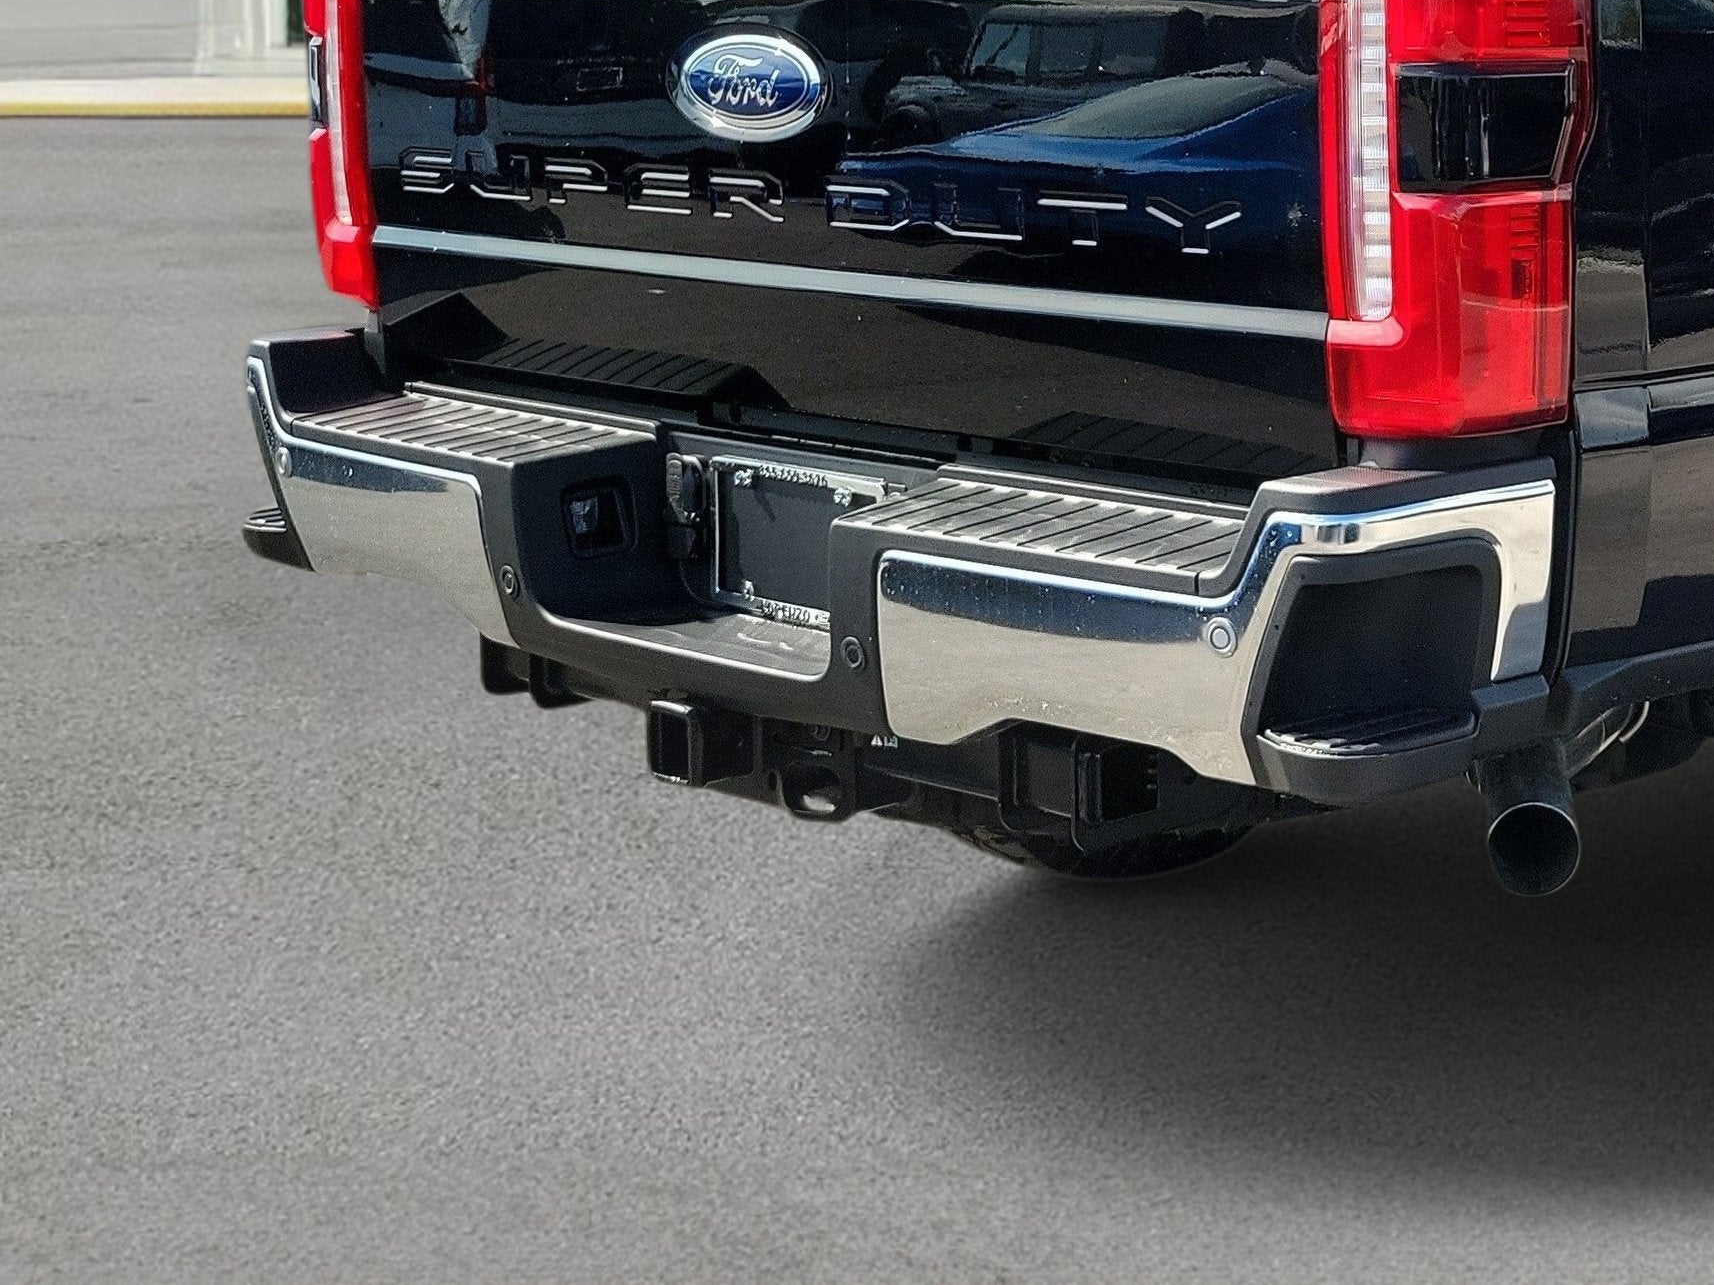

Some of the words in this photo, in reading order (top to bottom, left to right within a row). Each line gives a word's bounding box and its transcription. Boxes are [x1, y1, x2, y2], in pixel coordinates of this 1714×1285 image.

[706, 53, 781, 108] Ford
[400, 146, 785, 223] SUPER
[825, 174, 1243, 255] DUTY
